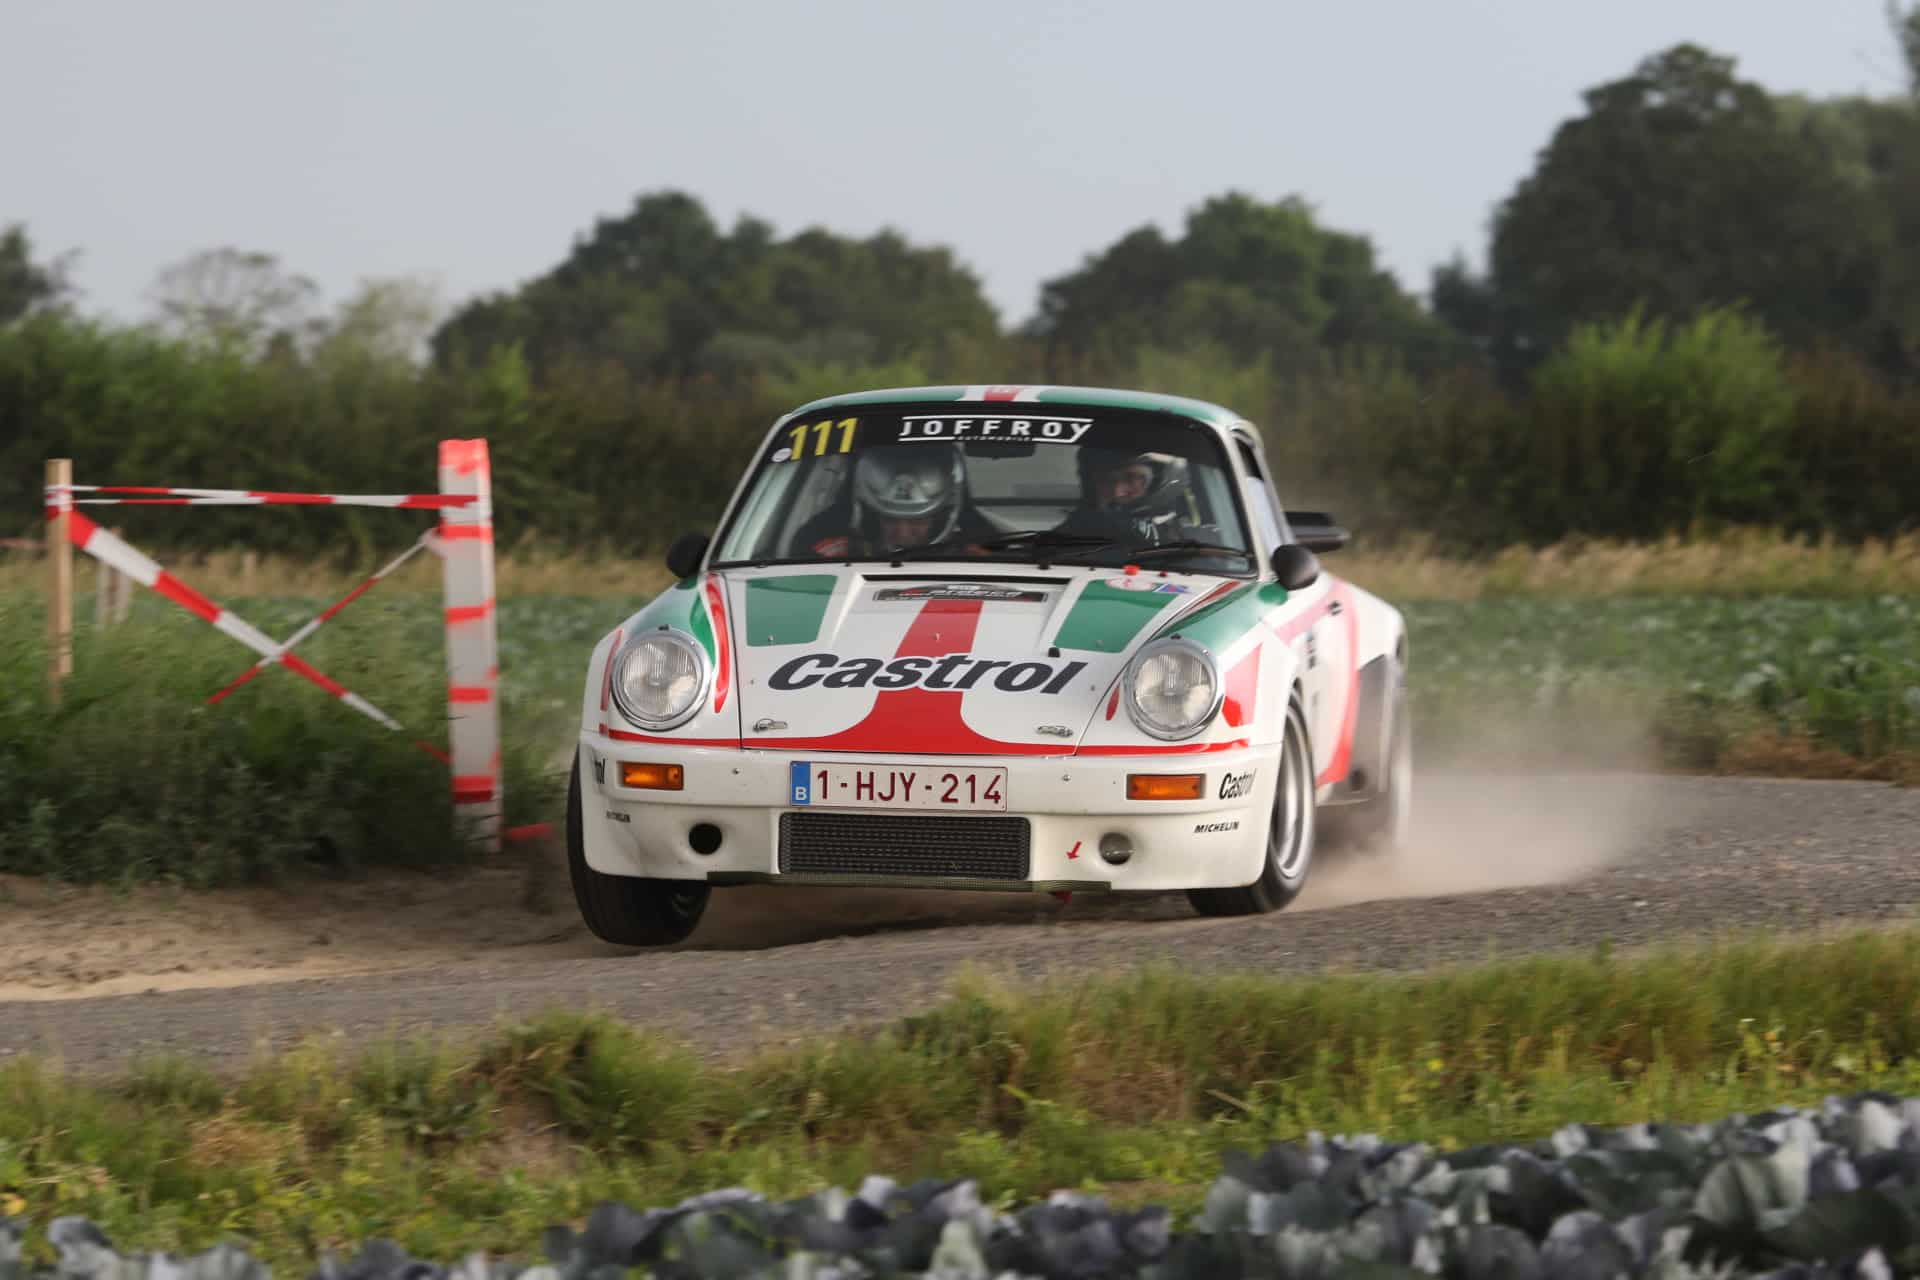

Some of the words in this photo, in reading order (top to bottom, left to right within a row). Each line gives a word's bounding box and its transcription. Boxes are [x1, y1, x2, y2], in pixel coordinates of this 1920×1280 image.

[789, 417, 857, 461] 111
[899, 419, 1092, 441] JOFFROY
[767, 653, 1088, 695] Castrol
[794, 786, 808, 801] B
[816, 770, 1002, 805] 1-HJY-214
[1193, 821, 1239, 834] MICHELIN
